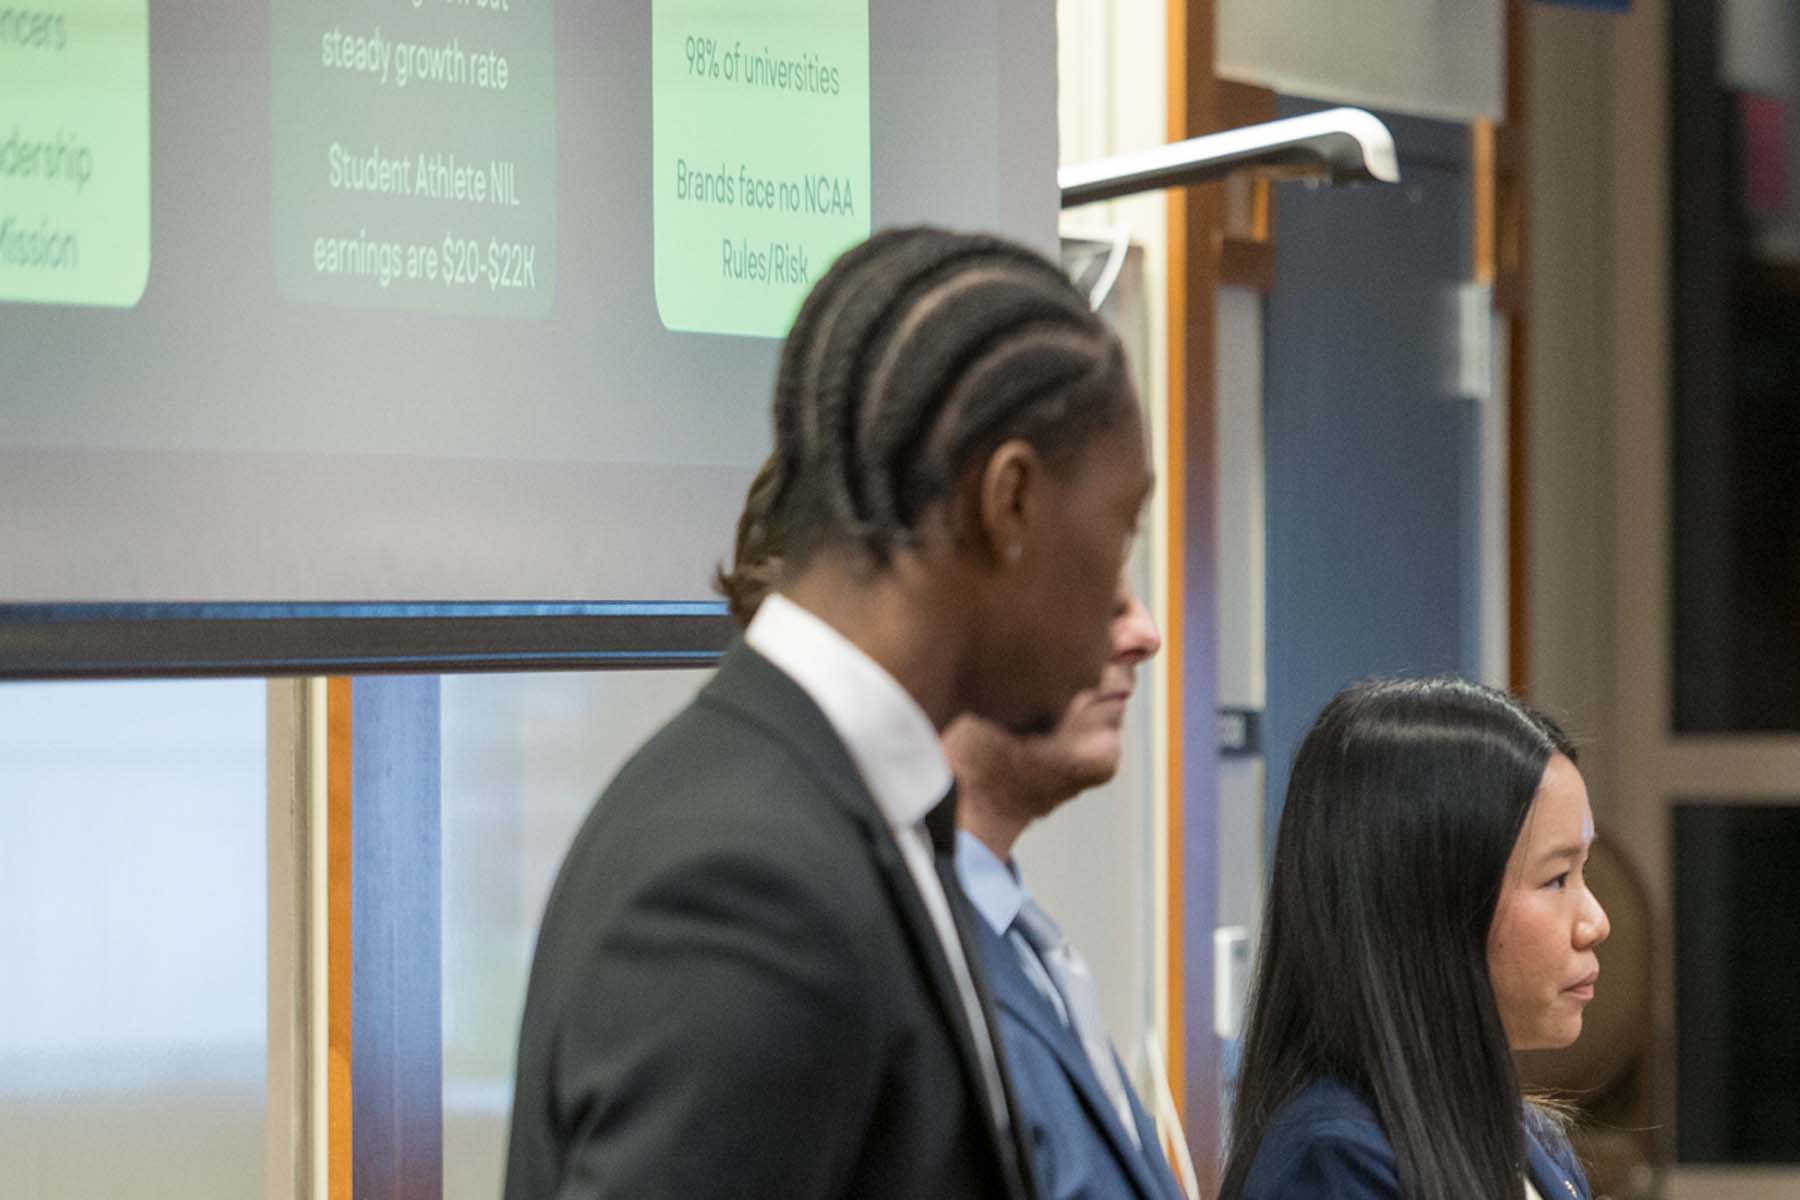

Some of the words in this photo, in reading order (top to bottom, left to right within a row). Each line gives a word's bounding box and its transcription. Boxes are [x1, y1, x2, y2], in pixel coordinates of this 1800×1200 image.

[321, 26, 391, 84] steady
[395, 39, 465, 87] growth
[470, 49, 509, 89] rate
[685, 35, 720, 79] 98%
[723, 41, 741, 81] of
[744, 47, 840, 95] universities
[328, 142, 411, 195] Student
[415, 152, 486, 202] Athlete
[490, 159, 520, 206] NIL
[676, 158, 734, 204] Brands
[738, 164, 775, 209] face
[779, 181, 800, 212] no
[804, 175, 854, 216] NCAA
[313, 228, 401, 288] earnings
[406, 244, 438, 280] are
[442, 232, 535, 292] $20-$22K
[722, 238, 809, 285] Rules/Risk
